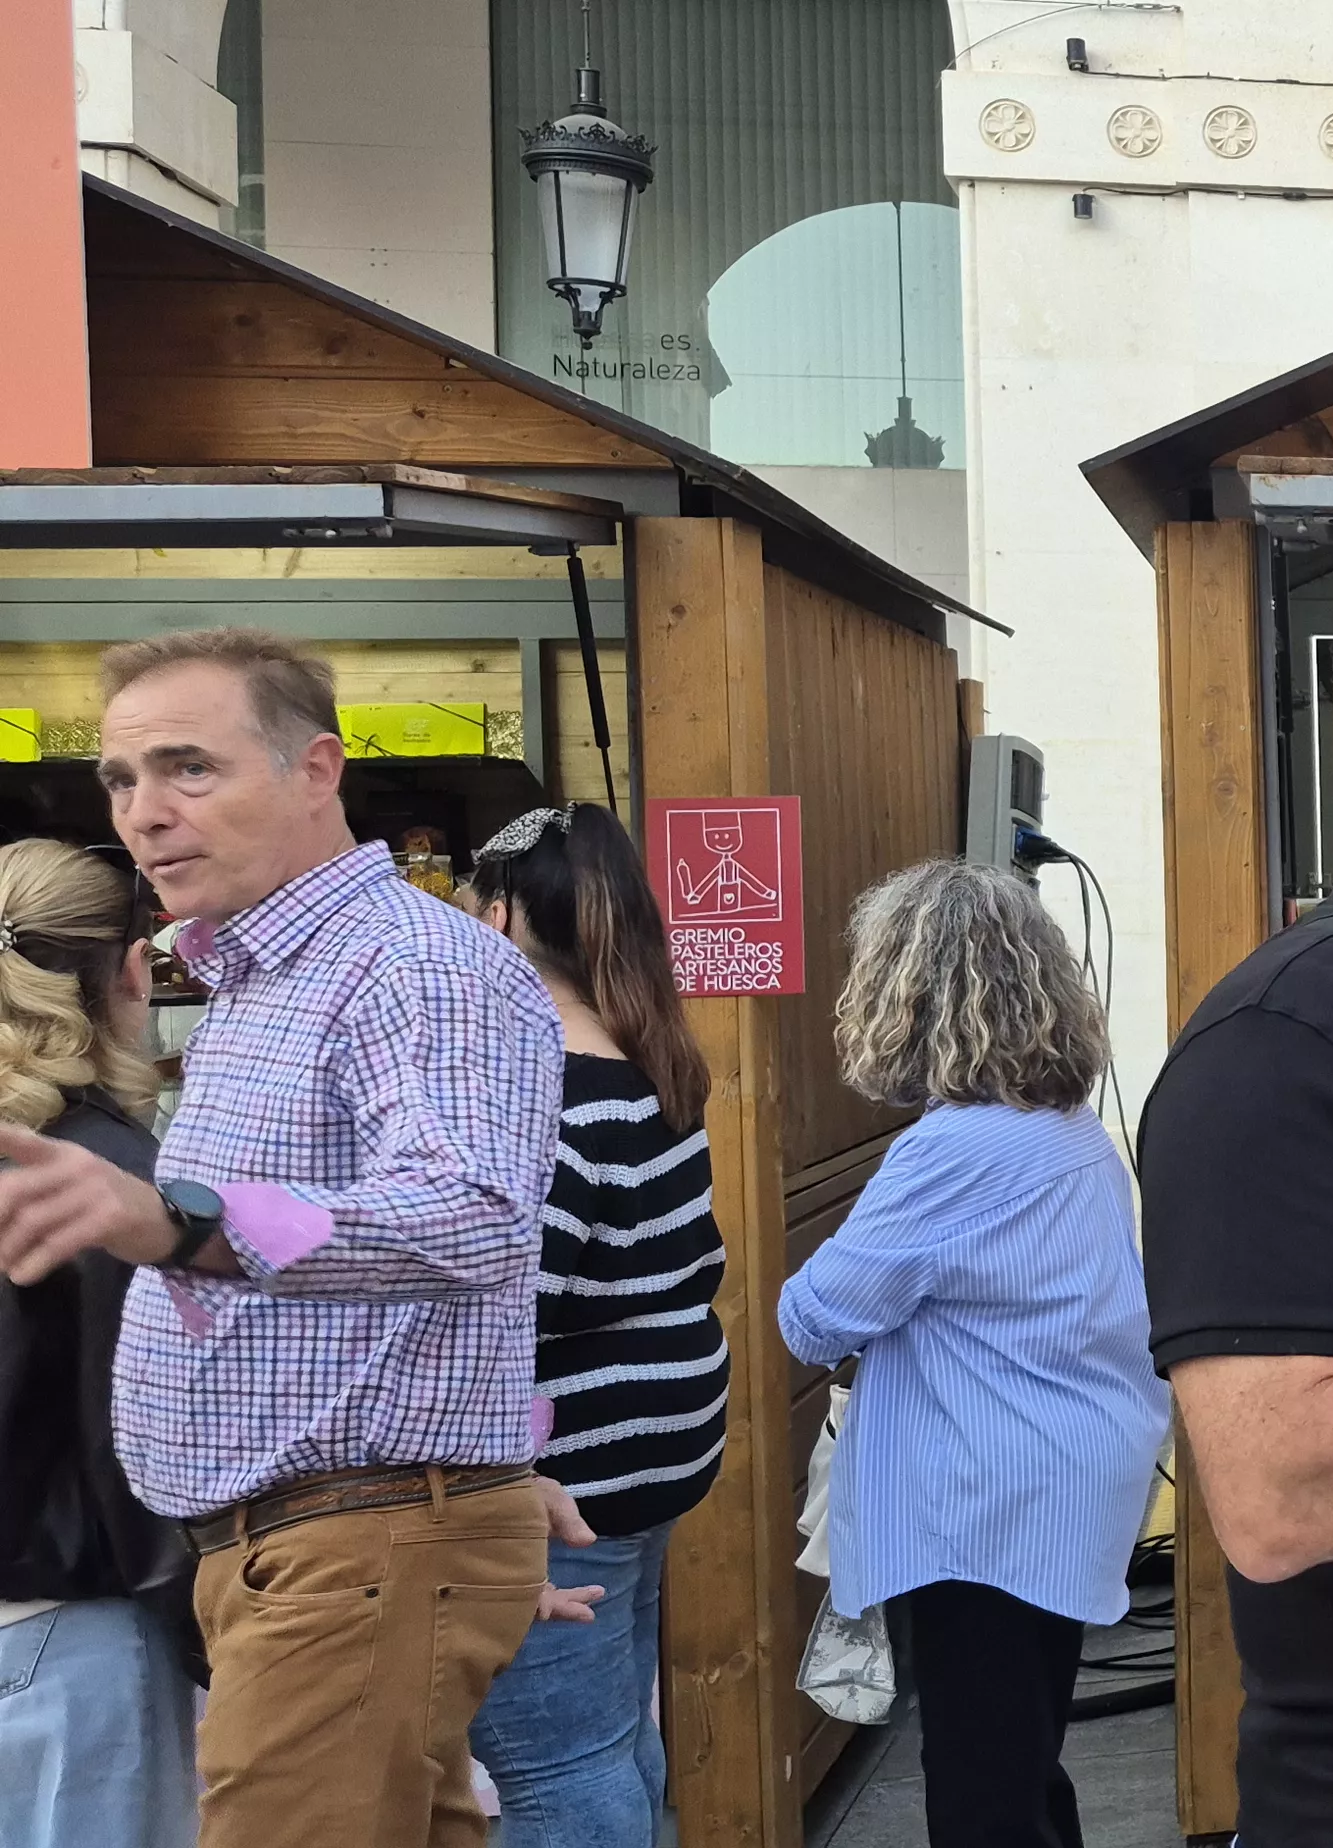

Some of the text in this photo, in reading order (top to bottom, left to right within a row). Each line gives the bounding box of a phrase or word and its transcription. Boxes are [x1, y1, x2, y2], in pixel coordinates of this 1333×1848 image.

[552, 354, 701, 381] Naturaleza
[669, 927, 745, 945] GREMIO
[670, 942, 784, 961] PASTELEROS
[671, 957, 783, 977] ARTESANOS
[674, 973, 782, 993] DE HUESCA
